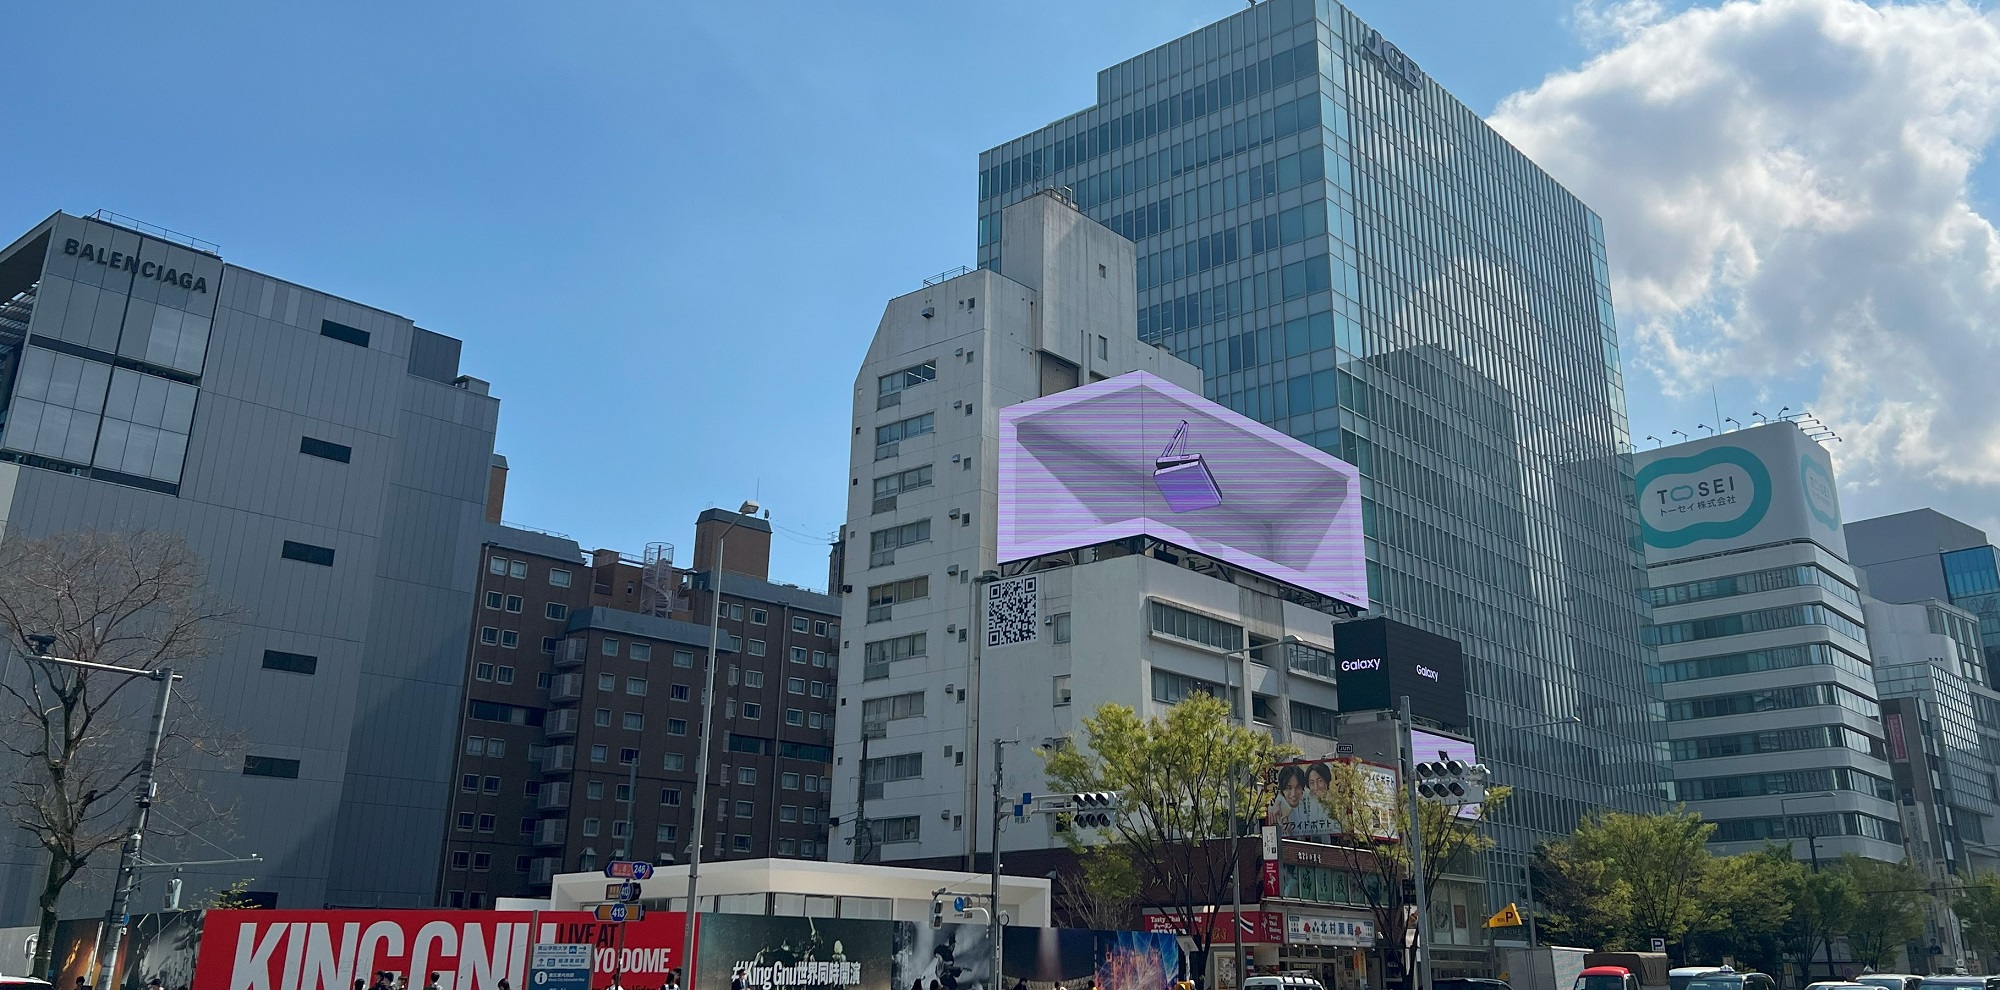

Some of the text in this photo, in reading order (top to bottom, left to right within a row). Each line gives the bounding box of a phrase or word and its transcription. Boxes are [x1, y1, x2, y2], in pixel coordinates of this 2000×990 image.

[1361, 29, 1423, 91] JCB
[64, 237, 207, 294] BALENCIAGA
[1659, 494, 1737, 517] トーセイ株式会社
[1341, 658, 1381, 672] Galaxy
[1416, 664, 1439, 682] Galaxy
[634, 864, 646, 874] 246
[612, 908, 624, 918] 413
[1505, 911, 1513, 922] P
[559, 923, 619, 948] LIVE AT
[1320, 920, 1354, 936] 北村薬局
[1652, 940, 1663, 950] P
[773, 961, 861, 986] Gnu世界同時開演
